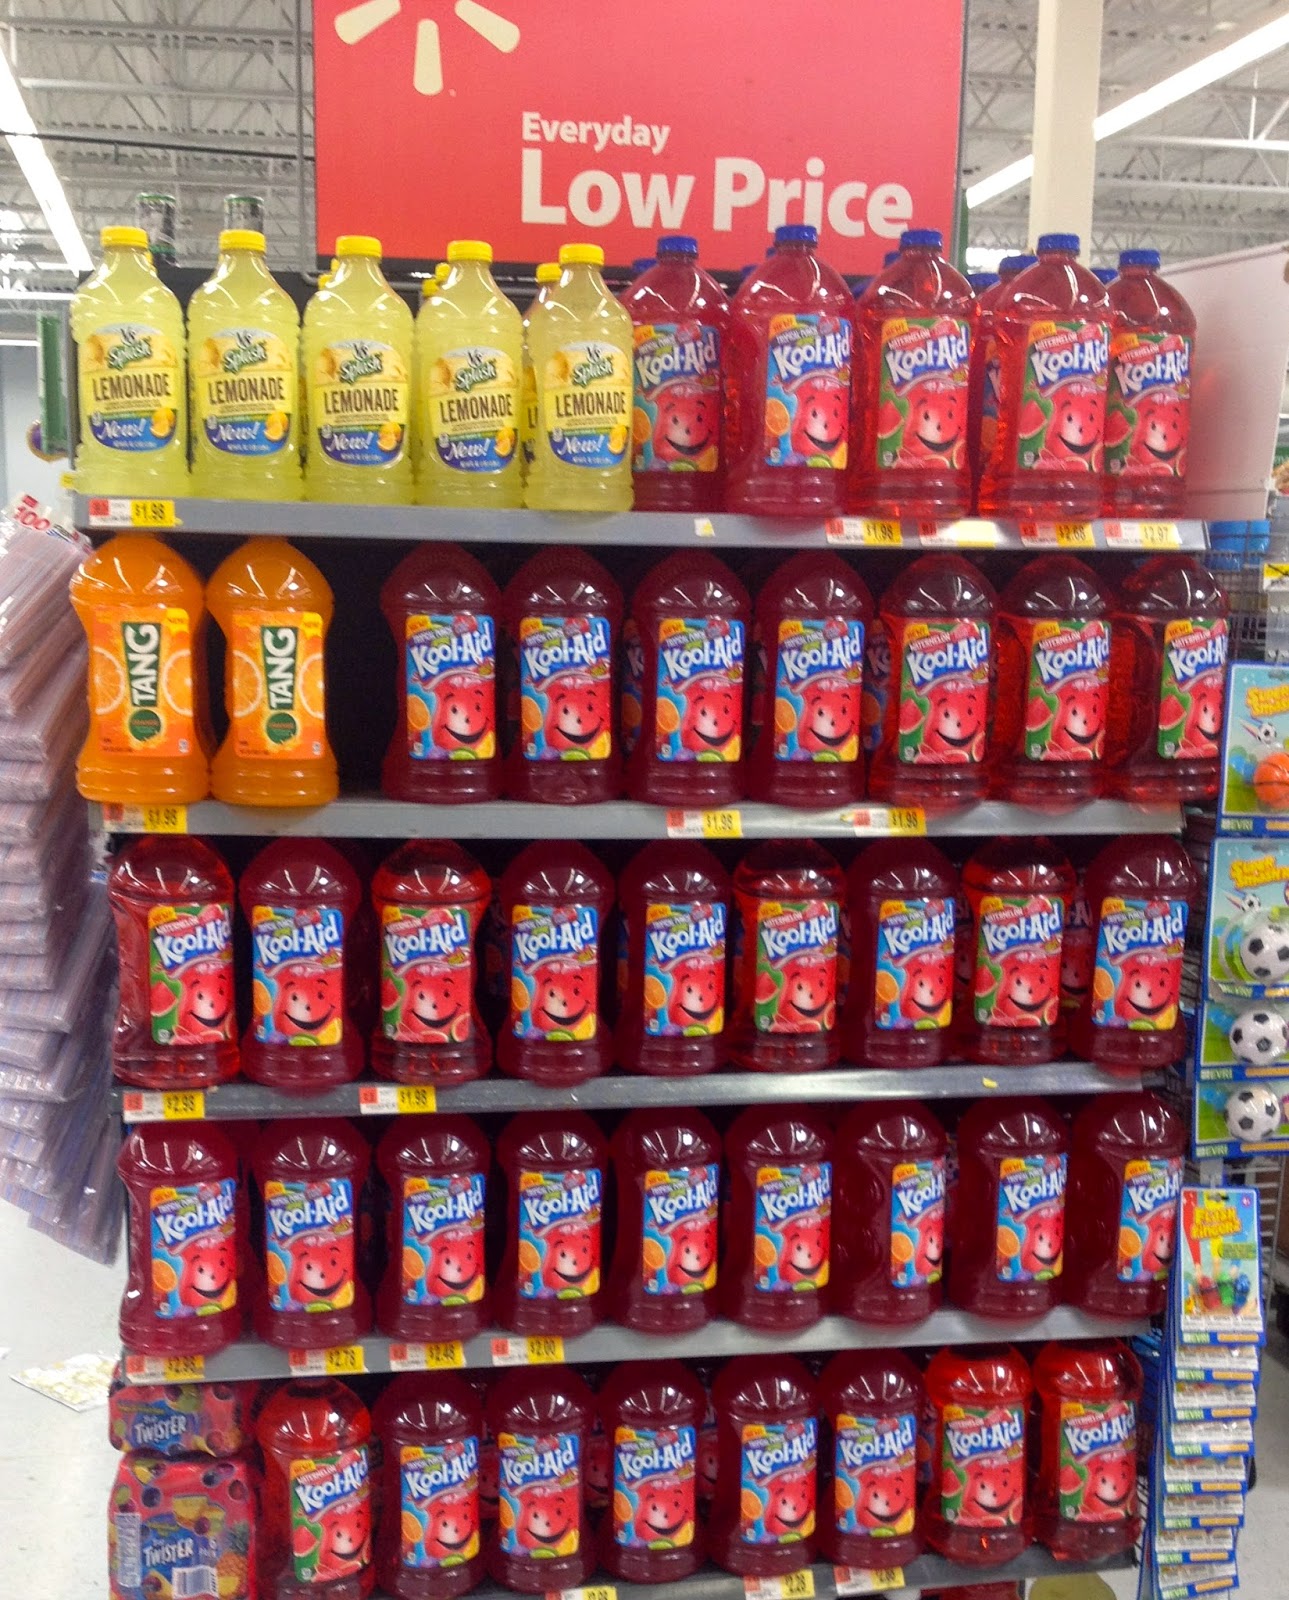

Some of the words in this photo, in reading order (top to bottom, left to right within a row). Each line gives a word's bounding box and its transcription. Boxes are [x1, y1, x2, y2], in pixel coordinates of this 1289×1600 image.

[522, 112, 670, 154] Everyday
[521, 147, 695, 229] Low
[714, 157, 913, 239] Price
[635, 332, 717, 389] Kool-Aid
[773, 327, 849, 381] Kool-Aid
[885, 327, 968, 387] Kool-Aid
[1031, 332, 1108, 386] Kool-Aid
[1114, 342, 1188, 395] Kool-Aid
[92, 374, 171, 401] LEMONADE
[208, 377, 285, 405] LEMONADE
[324, 388, 399, 414] LEMONADE
[439, 394, 512, 423] LEMONADE
[556, 392, 626, 418] LEMONADE
[124, 624, 160, 706] TANG
[263, 627, 297, 709] TANG
[411, 621, 492, 677] Kool-Aid
[525, 623, 607, 677] Kool-Aid
[663, 627, 741, 680] Kool-Aid
[782, 628, 861, 680] Kool-Aid
[907, 627, 987, 683] Kool-Aid
[1035, 627, 1109, 684] Kool-Aid
[256, 913, 339, 964] Kool-Aid
[384, 912, 465, 962] Kool-Aid
[514, 911, 593, 960] Kool-Aid
[650, 907, 724, 960] Kool-Aid
[760, 906, 836, 957] Kool-Aid
[884, 903, 954, 955] Kool-Aid
[982, 903, 1060, 953] Kool-Aid
[1104, 907, 1184, 953] Kool-Aid
[156, 1184, 234, 1243] Kool-Aid
[269, 1183, 348, 1236] Kool-Aid
[407, 1179, 482, 1232] Kool-Aid
[523, 1172, 599, 1226] Kool-Aid
[648, 1170, 718, 1224] Kool-Aid
[760, 1168, 830, 1220] Kool-Aid
[134, 1415, 187, 1443] TWISTER
[618, 1431, 692, 1478] Kool-Aid
[746, 1423, 815, 1476] Kool-Aid
[839, 1422, 913, 1466] Kool-Aid
[946, 1411, 1021, 1456] Kool-Aid
[295, 1450, 368, 1511] Kool-Aid
[405, 1439, 477, 1498] Kool-Aid
[501, 1437, 574, 1485] Kool-Aid
[143, 1538, 194, 1567] TWISTER
